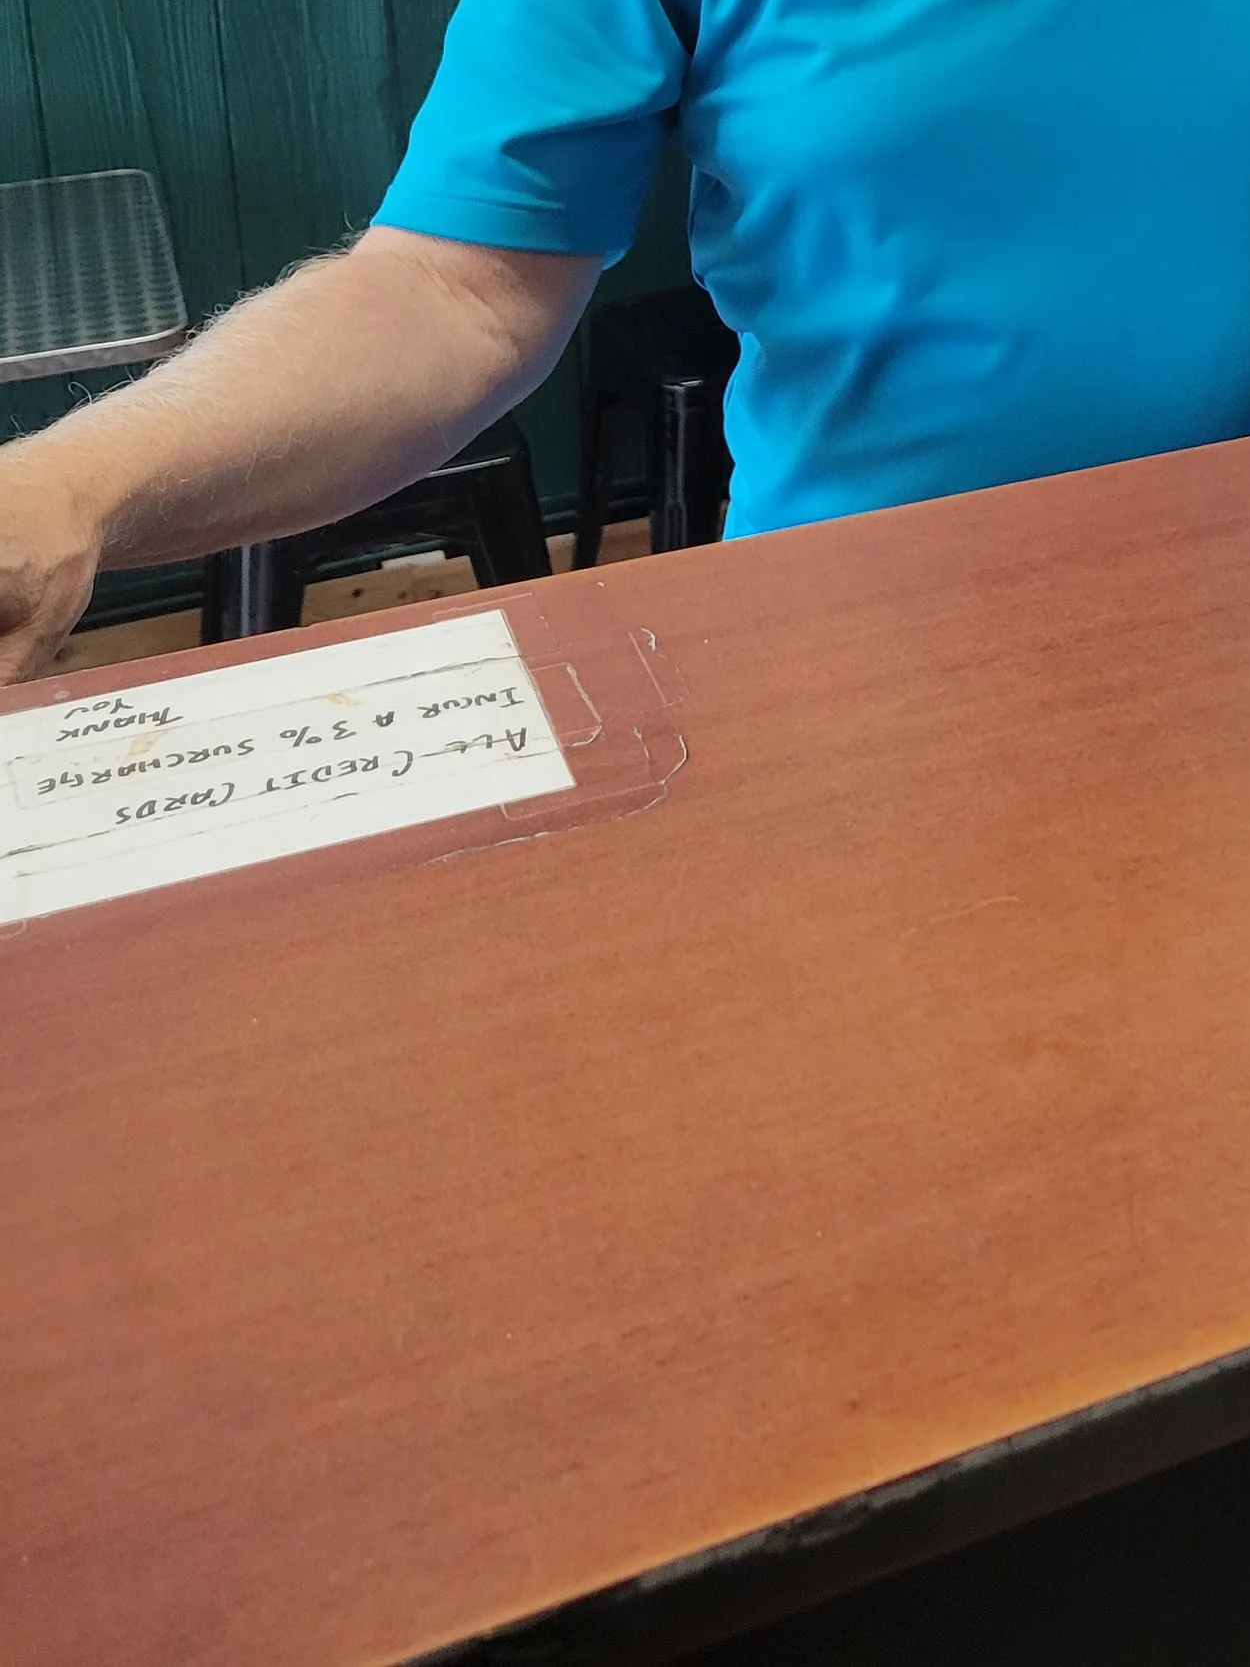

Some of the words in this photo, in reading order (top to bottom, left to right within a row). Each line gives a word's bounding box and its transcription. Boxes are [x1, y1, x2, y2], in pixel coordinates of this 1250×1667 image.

[372, 710, 395, 728] A
[417, 686, 525, 720] INCUR
[56, 707, 184, 742] THANK
[37, 738, 256, 796] SURCHARGE
[258, 750, 414, 796] CREDIT
[115, 782, 236, 825] CARDS
